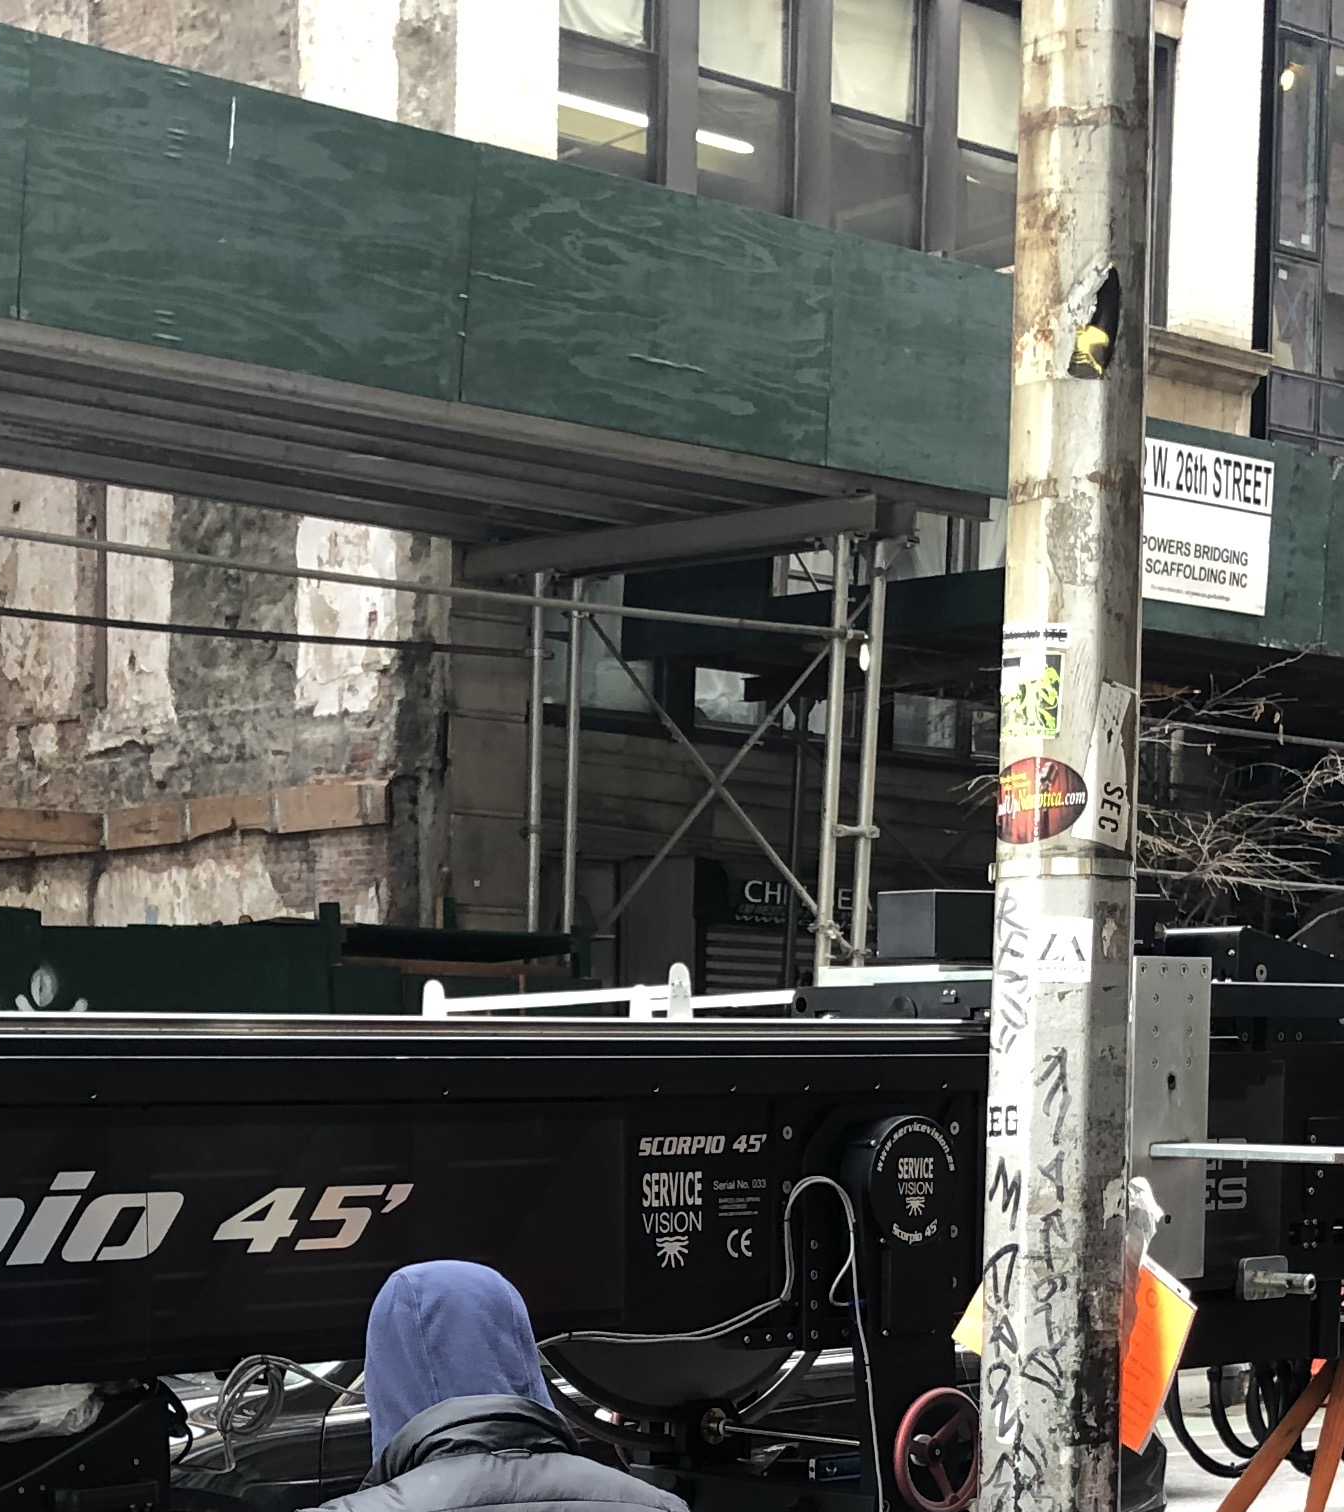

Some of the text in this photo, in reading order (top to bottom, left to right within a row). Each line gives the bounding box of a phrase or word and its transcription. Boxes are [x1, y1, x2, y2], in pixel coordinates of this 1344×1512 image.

[1152, 444, 1171, 490] W.
[1175, 449, 1208, 496] 26th
[1212, 456, 1272, 508] STREET
[1141, 534, 1249, 567] POWERS BRIDGING
[1144, 557, 1248, 588] SCAFFOLDING INC
[1098, 781, 1125, 833] SEC
[638, 1133, 767, 1157] SCORPIO 45'
[897, 1156, 934, 1179] SERVICE
[642, 1170, 703, 1208] SERVICE
[712, 1179, 735, 1190] Serial
[897, 1181, 934, 1196] VISION
[213, 1183, 415, 1254] 45'
[641, 1210, 702, 1234] VISION
[892, 1222, 923, 1245] Scorpio
